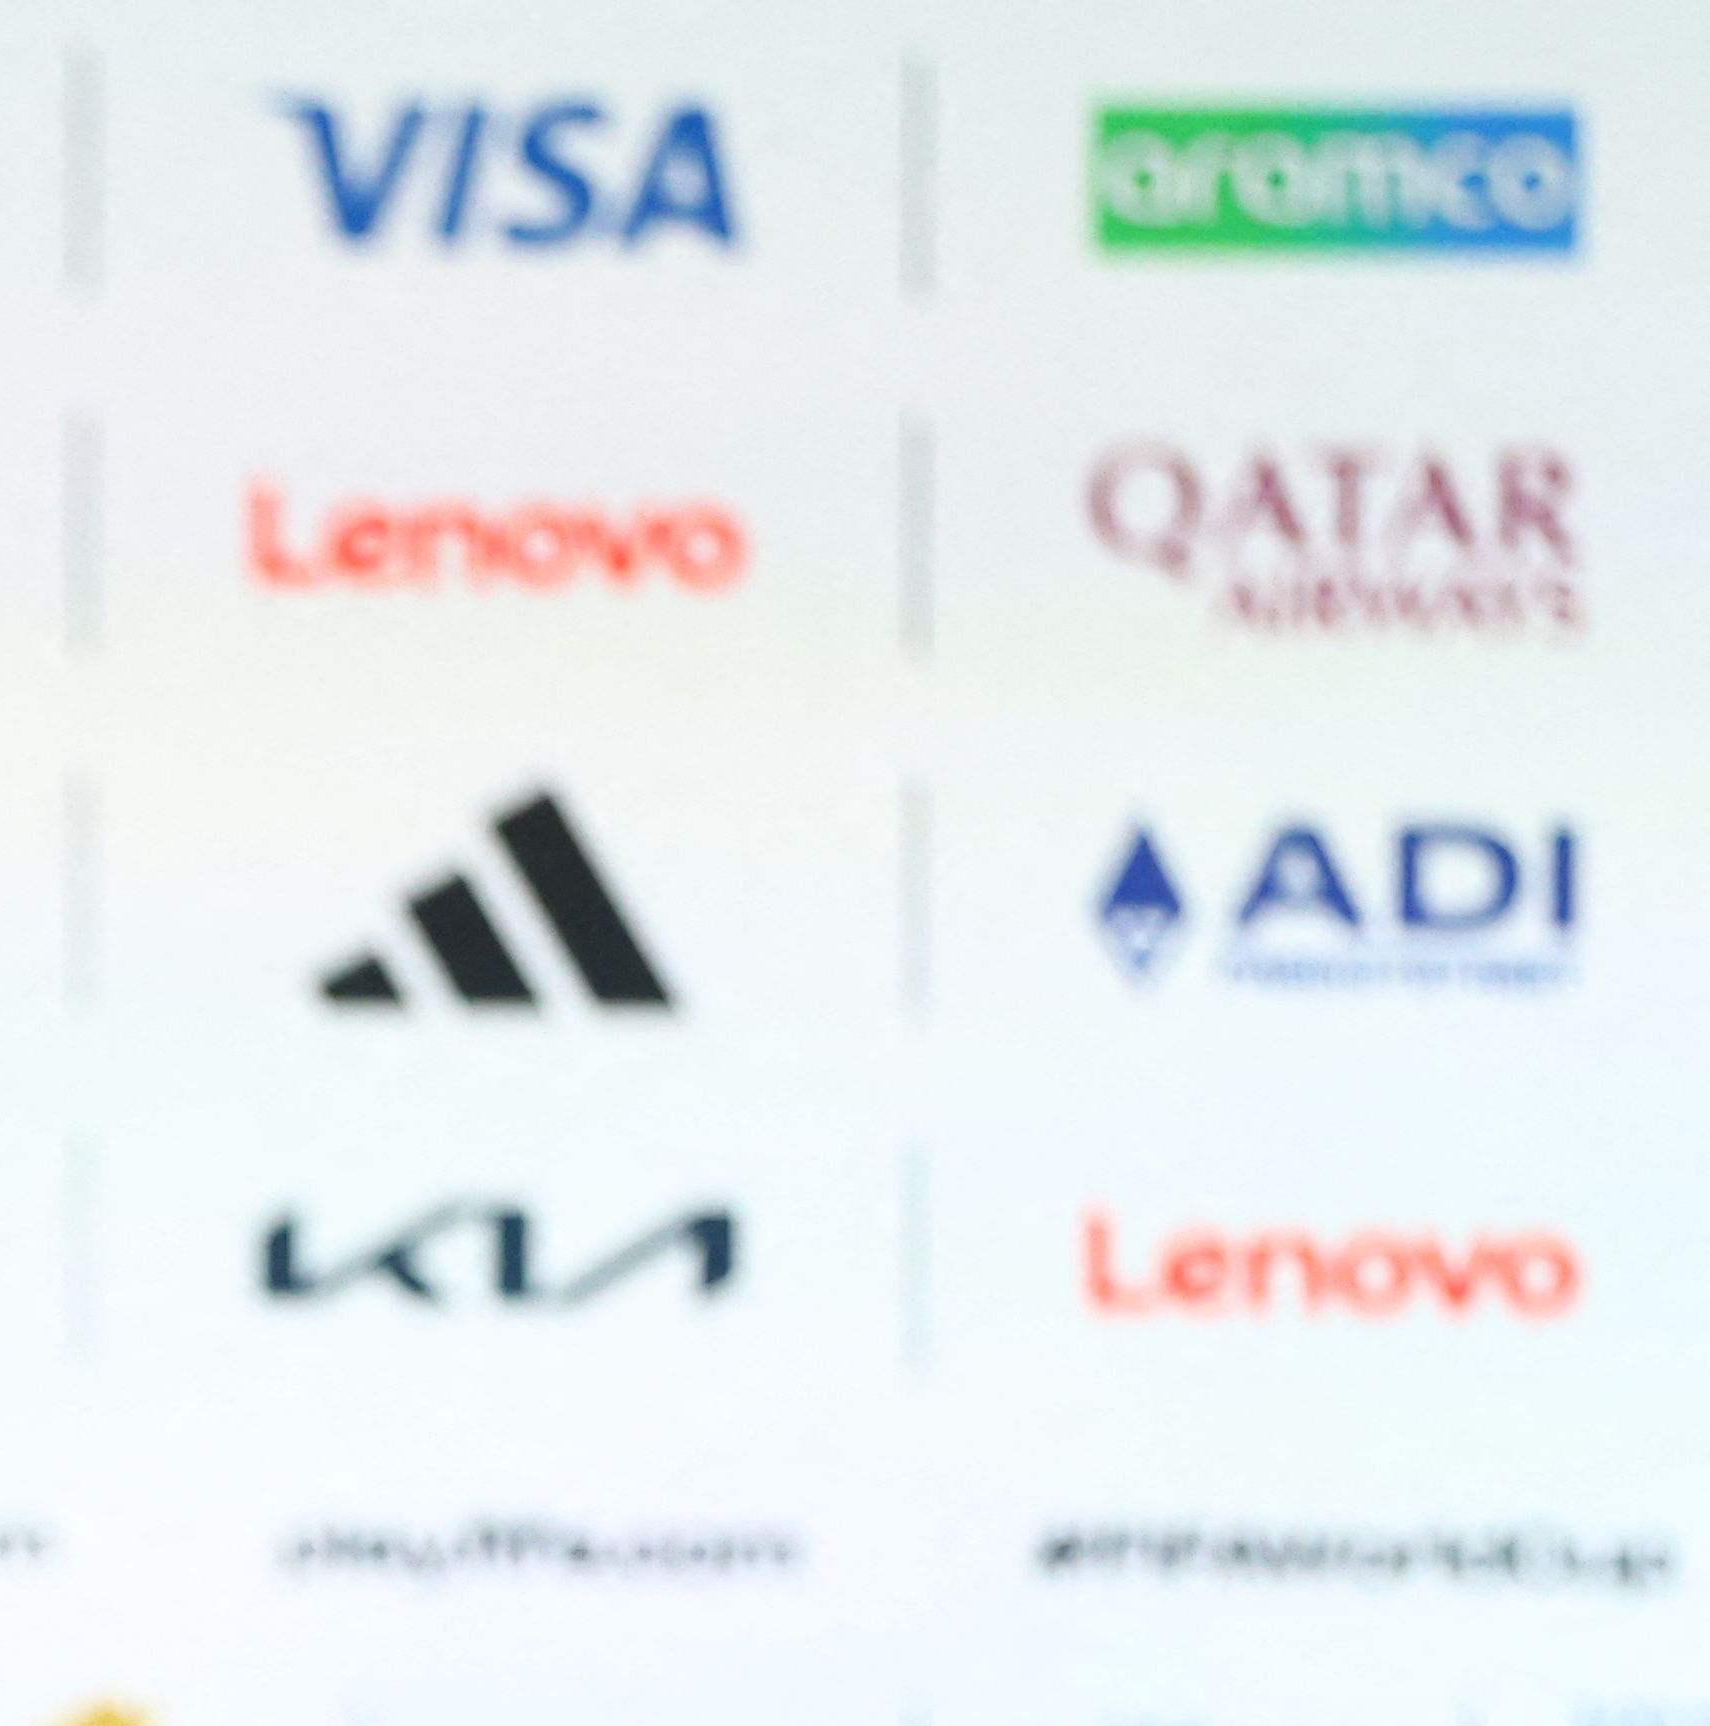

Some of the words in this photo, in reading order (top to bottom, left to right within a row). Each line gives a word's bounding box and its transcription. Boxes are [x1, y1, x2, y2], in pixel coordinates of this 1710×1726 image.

[286, 98, 737, 245] VISA
[1103, 130, 1573, 232] aramco
[249, 485, 746, 592] Lenovo
[1086, 442, 1573, 576] QATAR
[1237, 824, 1577, 932] ADI
[1085, 1212, 1579, 1316] Lenovo
